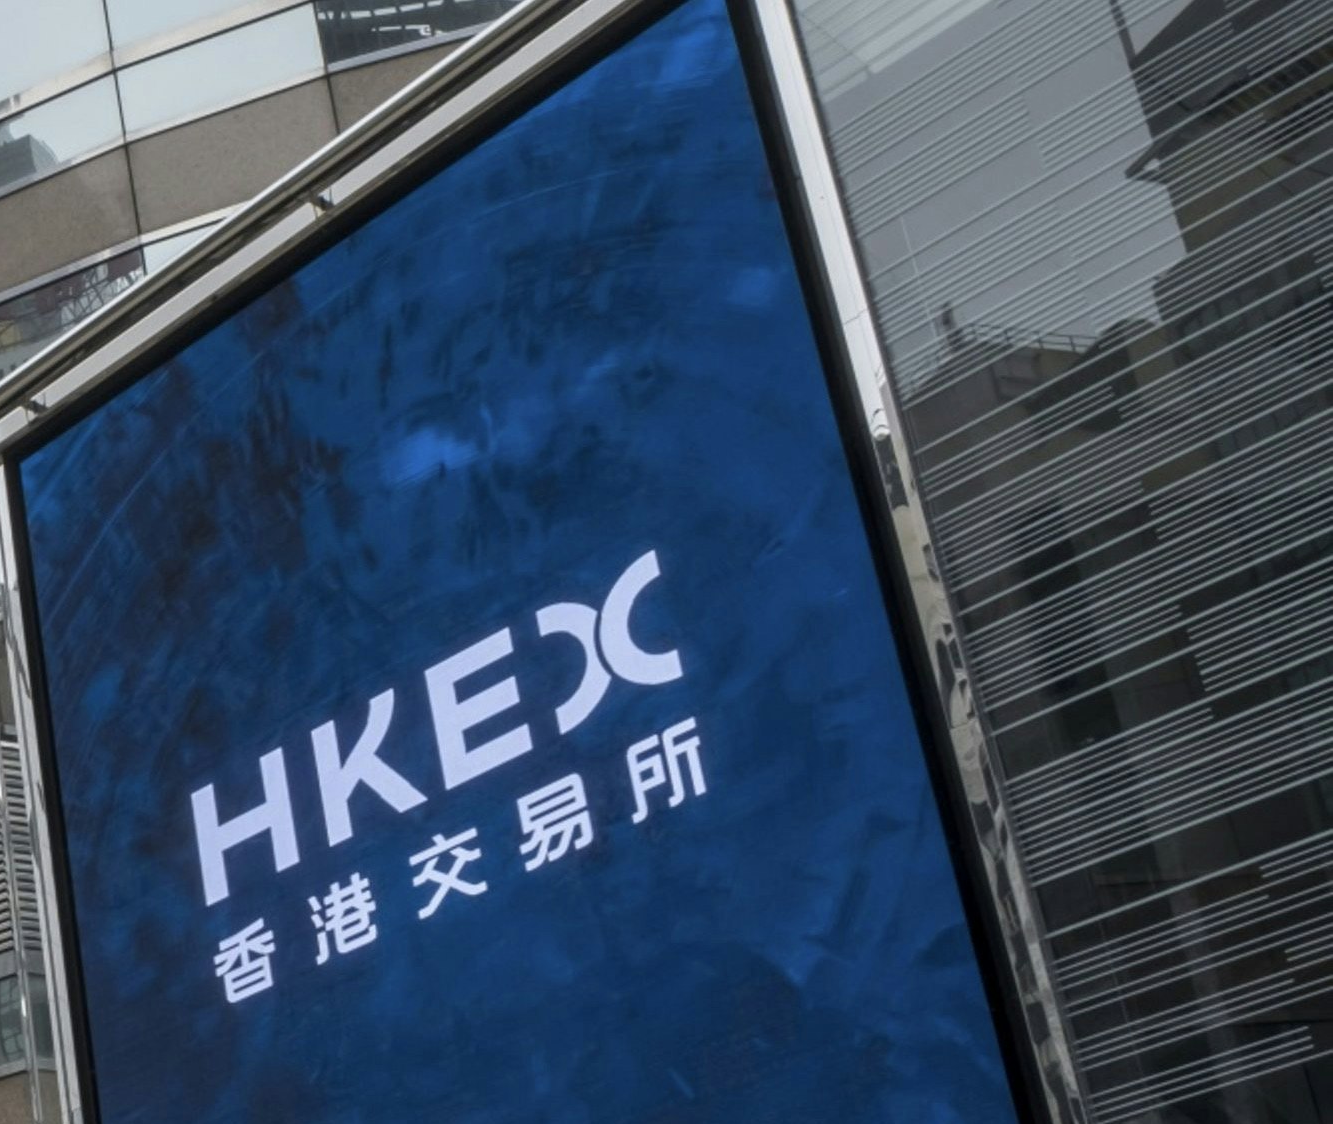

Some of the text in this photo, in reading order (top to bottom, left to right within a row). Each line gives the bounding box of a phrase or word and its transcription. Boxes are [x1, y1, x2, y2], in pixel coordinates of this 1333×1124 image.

[190, 549, 683, 906] HKEX
[213, 716, 708, 1004] 香港交易所
